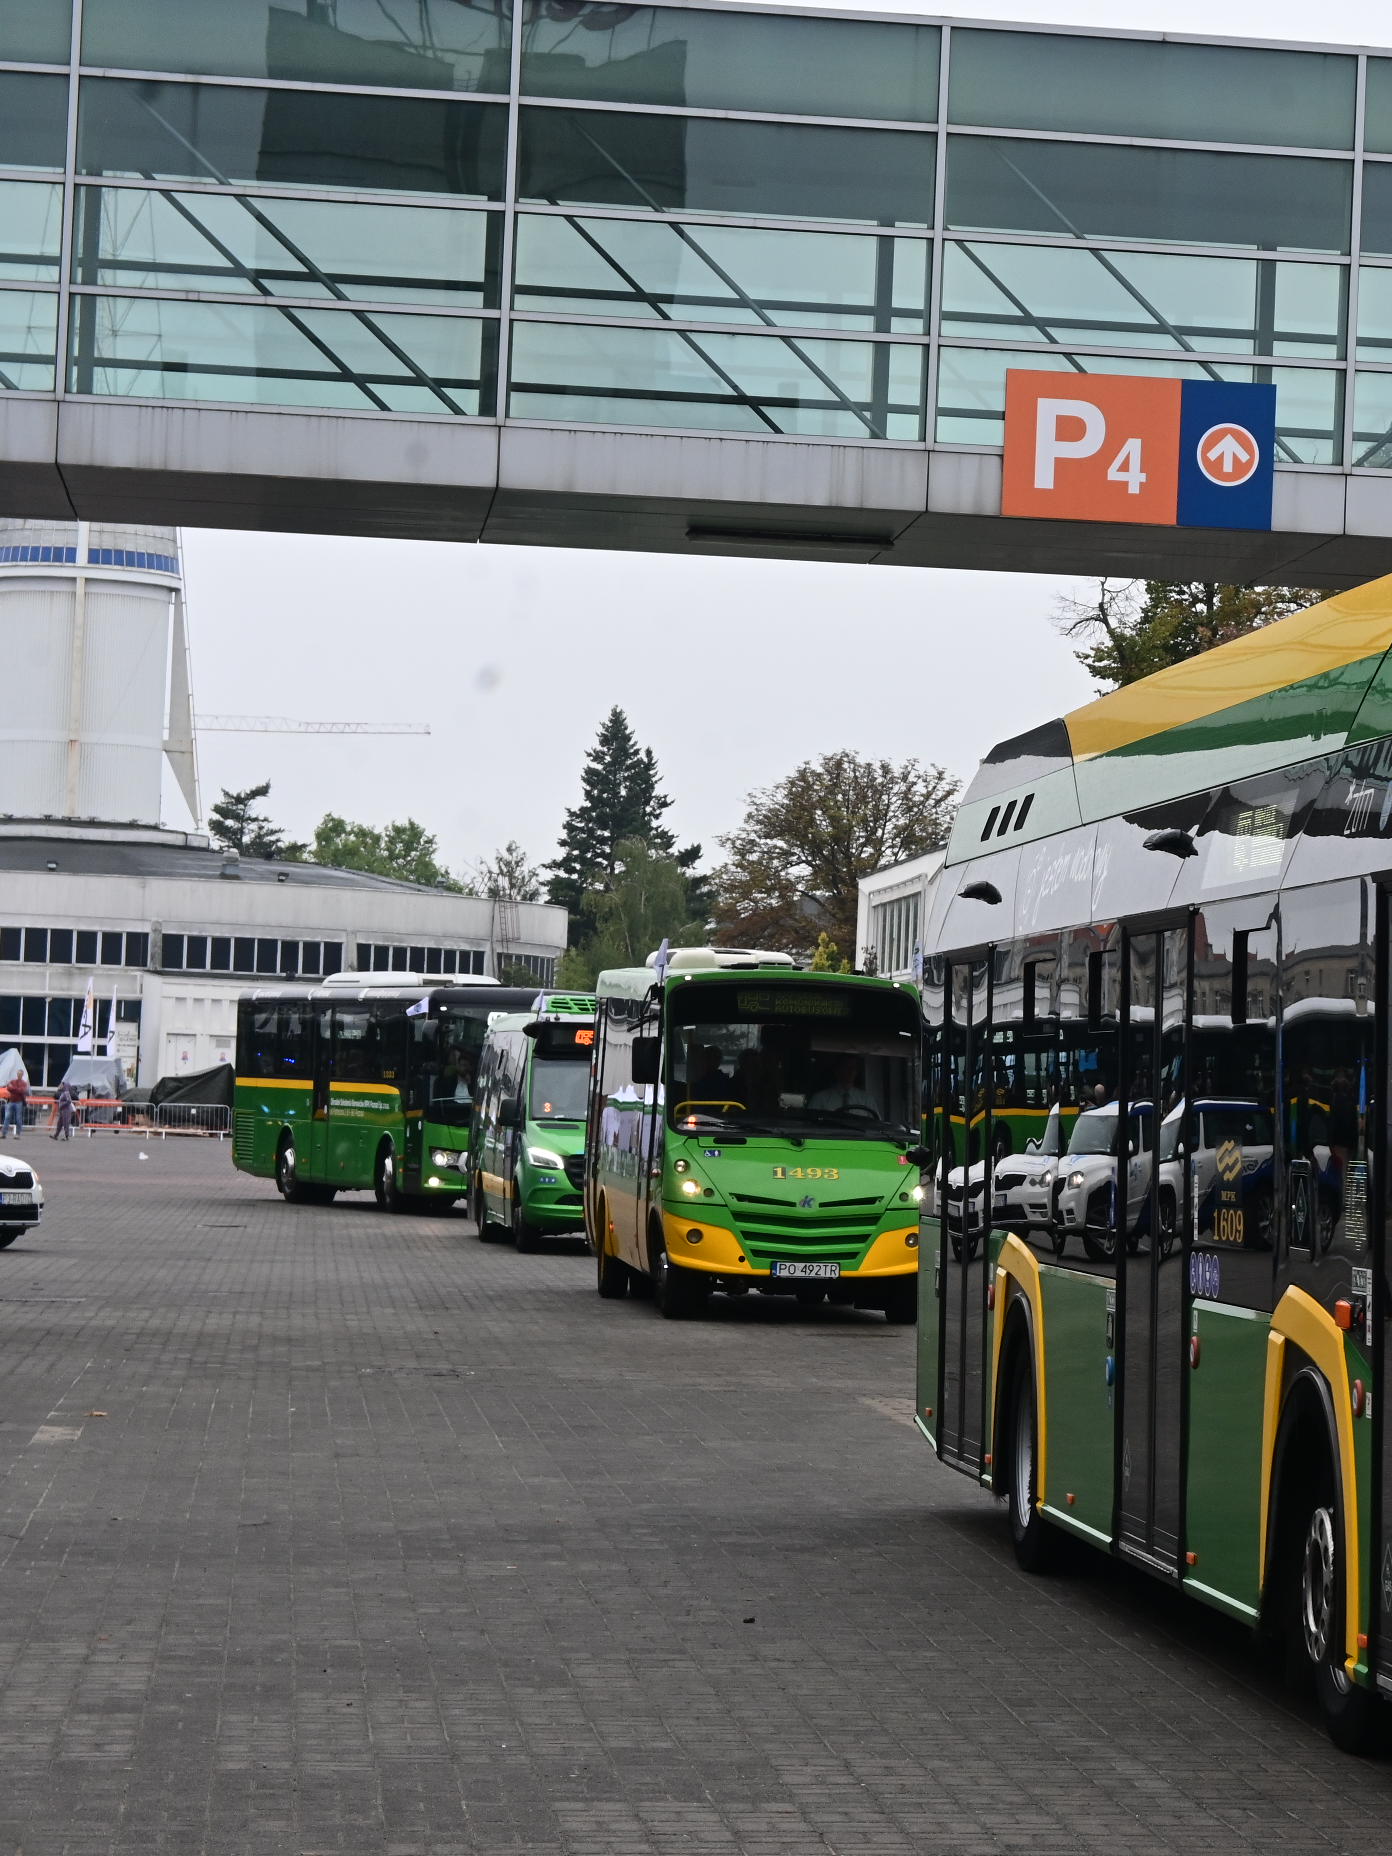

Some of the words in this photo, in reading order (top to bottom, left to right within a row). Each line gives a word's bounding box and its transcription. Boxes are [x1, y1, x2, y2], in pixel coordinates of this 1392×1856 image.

[773, 1167, 839, 1180] 1493
[1220, 1190, 1237, 1201] MPK
[1213, 1208, 1244, 1243] 1609
[778, 1263, 796, 1275] PO
[800, 1264, 838, 1276] 492TR
